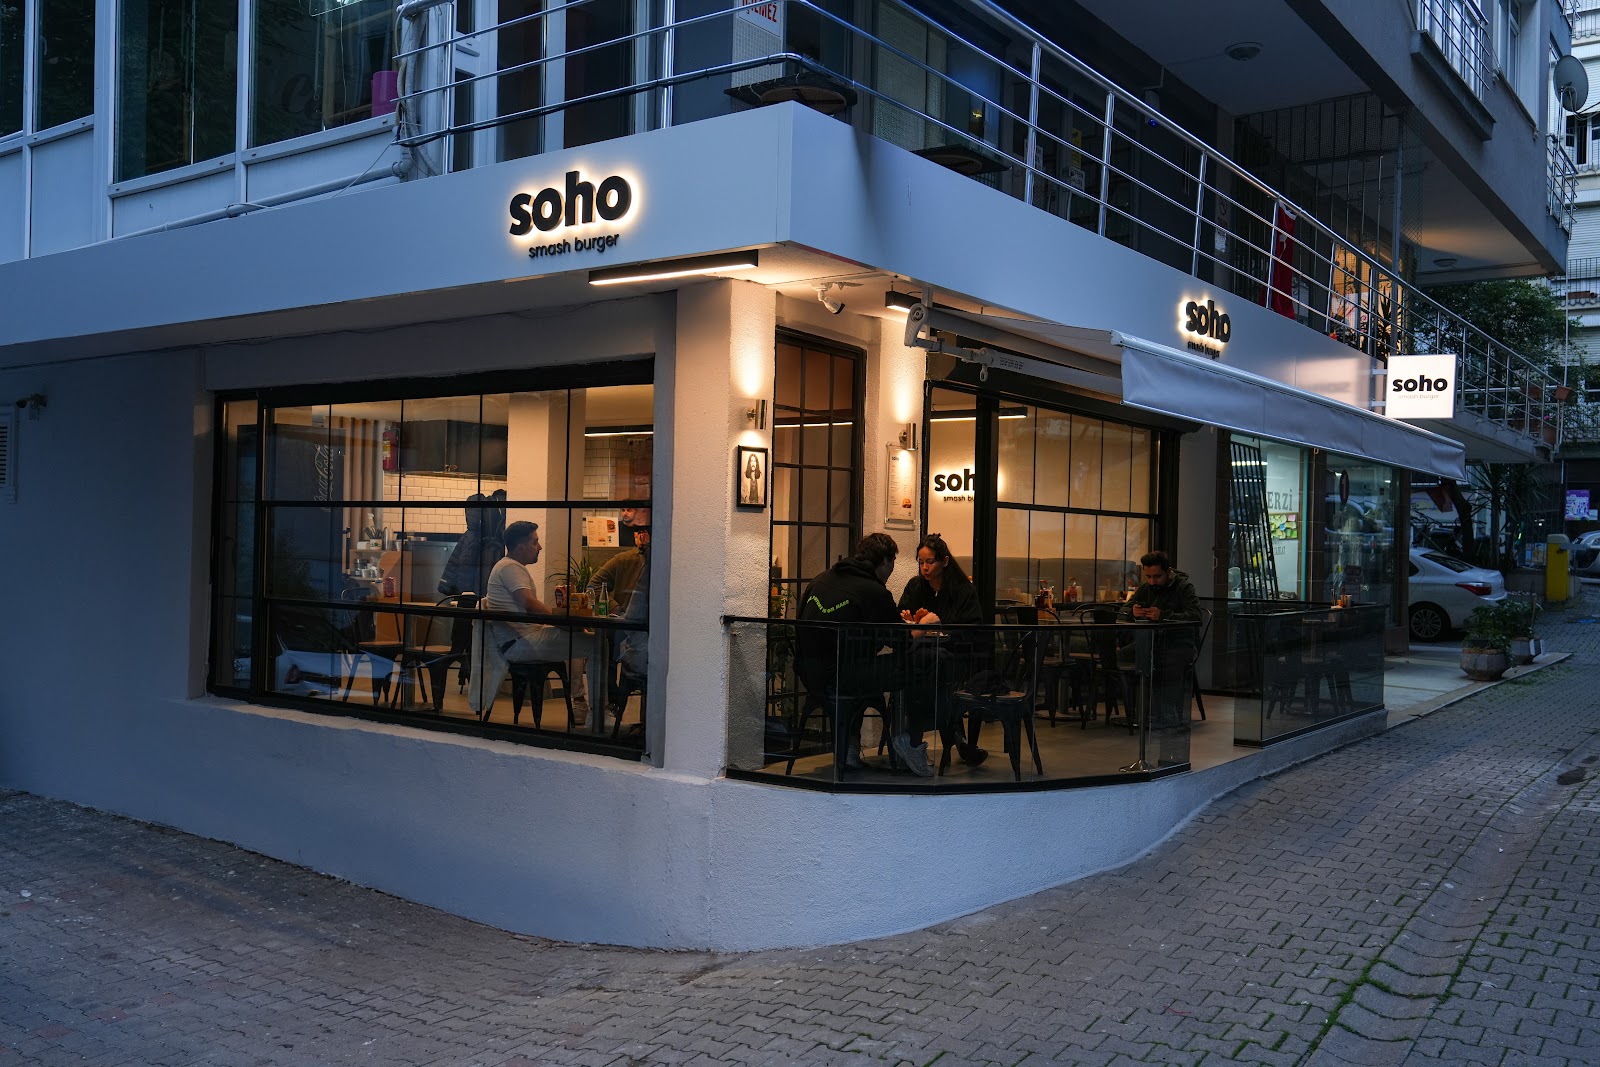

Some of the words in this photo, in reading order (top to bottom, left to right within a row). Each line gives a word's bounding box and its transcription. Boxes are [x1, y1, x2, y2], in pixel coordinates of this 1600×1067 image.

[509, 171, 632, 235] soho
[528, 239, 571, 259] smash
[574, 234, 620, 253] burger
[1186, 300, 1231, 343] soho
[1392, 375, 1448, 392] soho
[934, 468, 975, 492] soh
[1267, 488, 1293, 511] ERZİ
